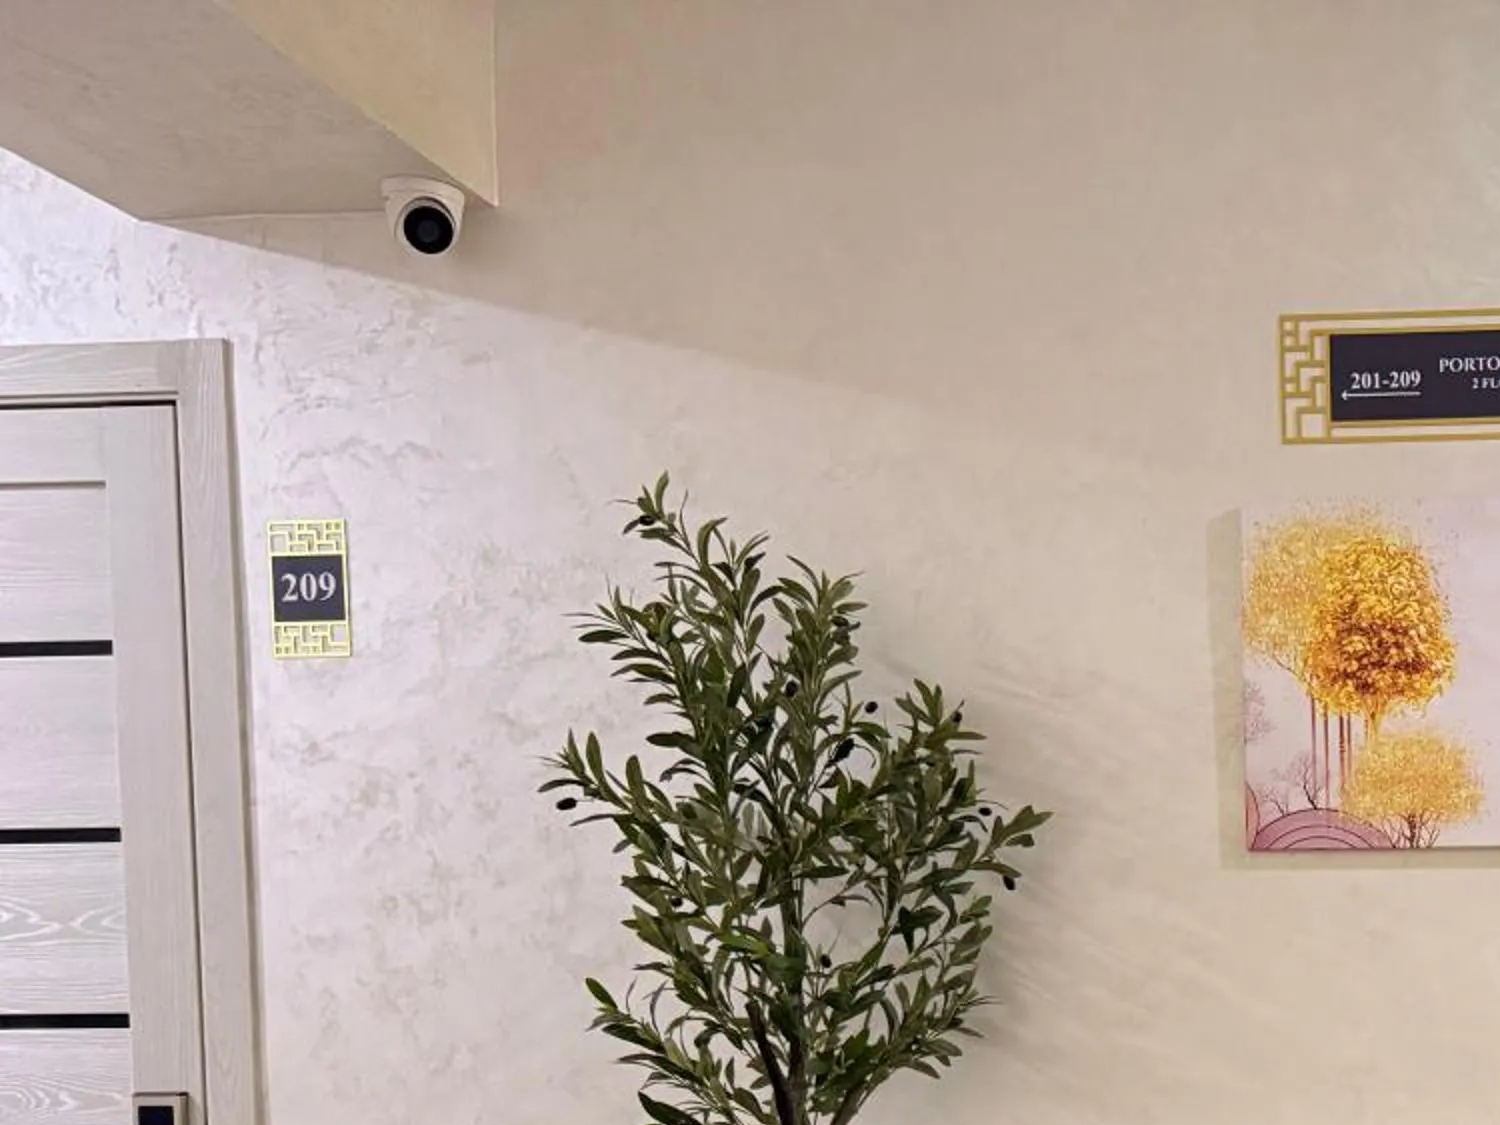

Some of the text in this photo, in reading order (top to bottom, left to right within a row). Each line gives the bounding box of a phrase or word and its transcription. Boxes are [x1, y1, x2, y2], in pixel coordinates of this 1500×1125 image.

[1439, 356, 1500, 374] PORTO
[1350, 371, 1422, 390] 201-209
[1471, 377, 1480, 390] 2
[281, 571, 337, 603] 209
